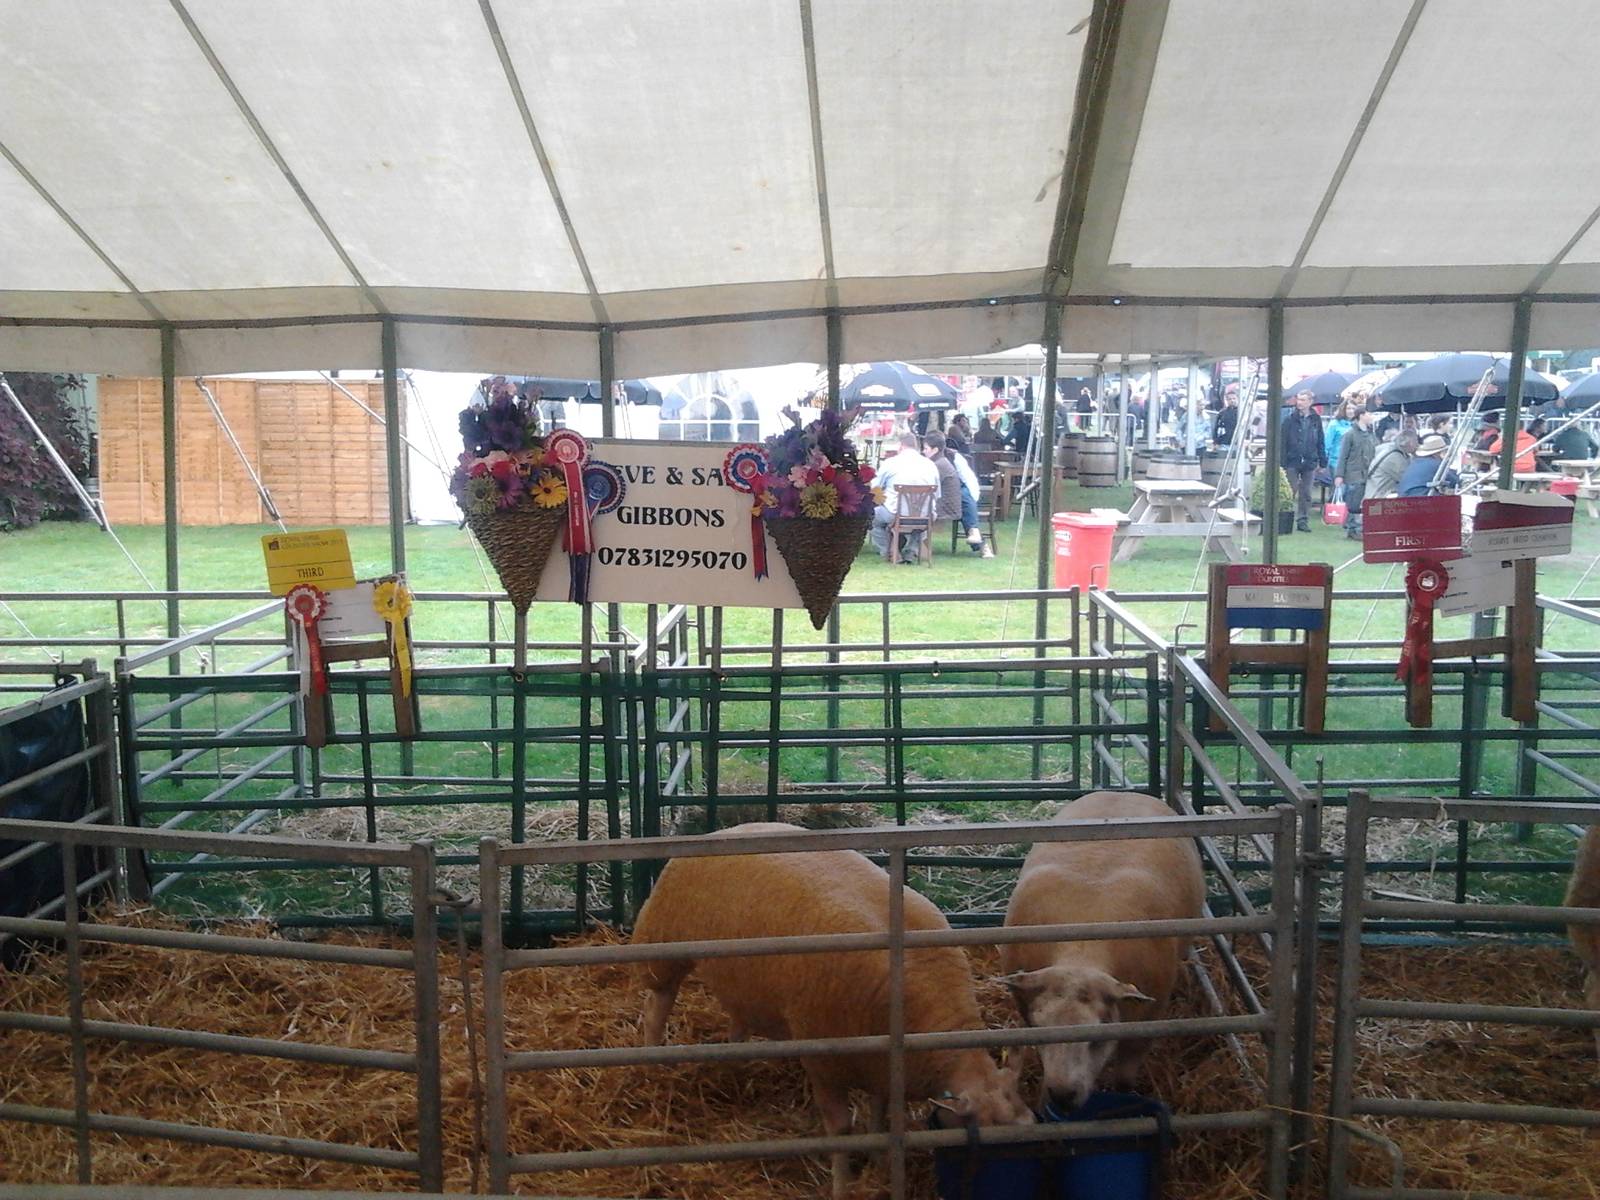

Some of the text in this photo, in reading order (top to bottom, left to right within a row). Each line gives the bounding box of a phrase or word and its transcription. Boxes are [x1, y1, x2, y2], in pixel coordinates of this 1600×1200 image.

[666, 466, 684, 485] &
[691, 467, 724, 487] SA
[617, 505, 725, 528] GIBBONS
[1395, 535, 1427, 547] FIRST
[597, 547, 748, 571] 07831295070
[296, 566, 325, 579] THIRD
